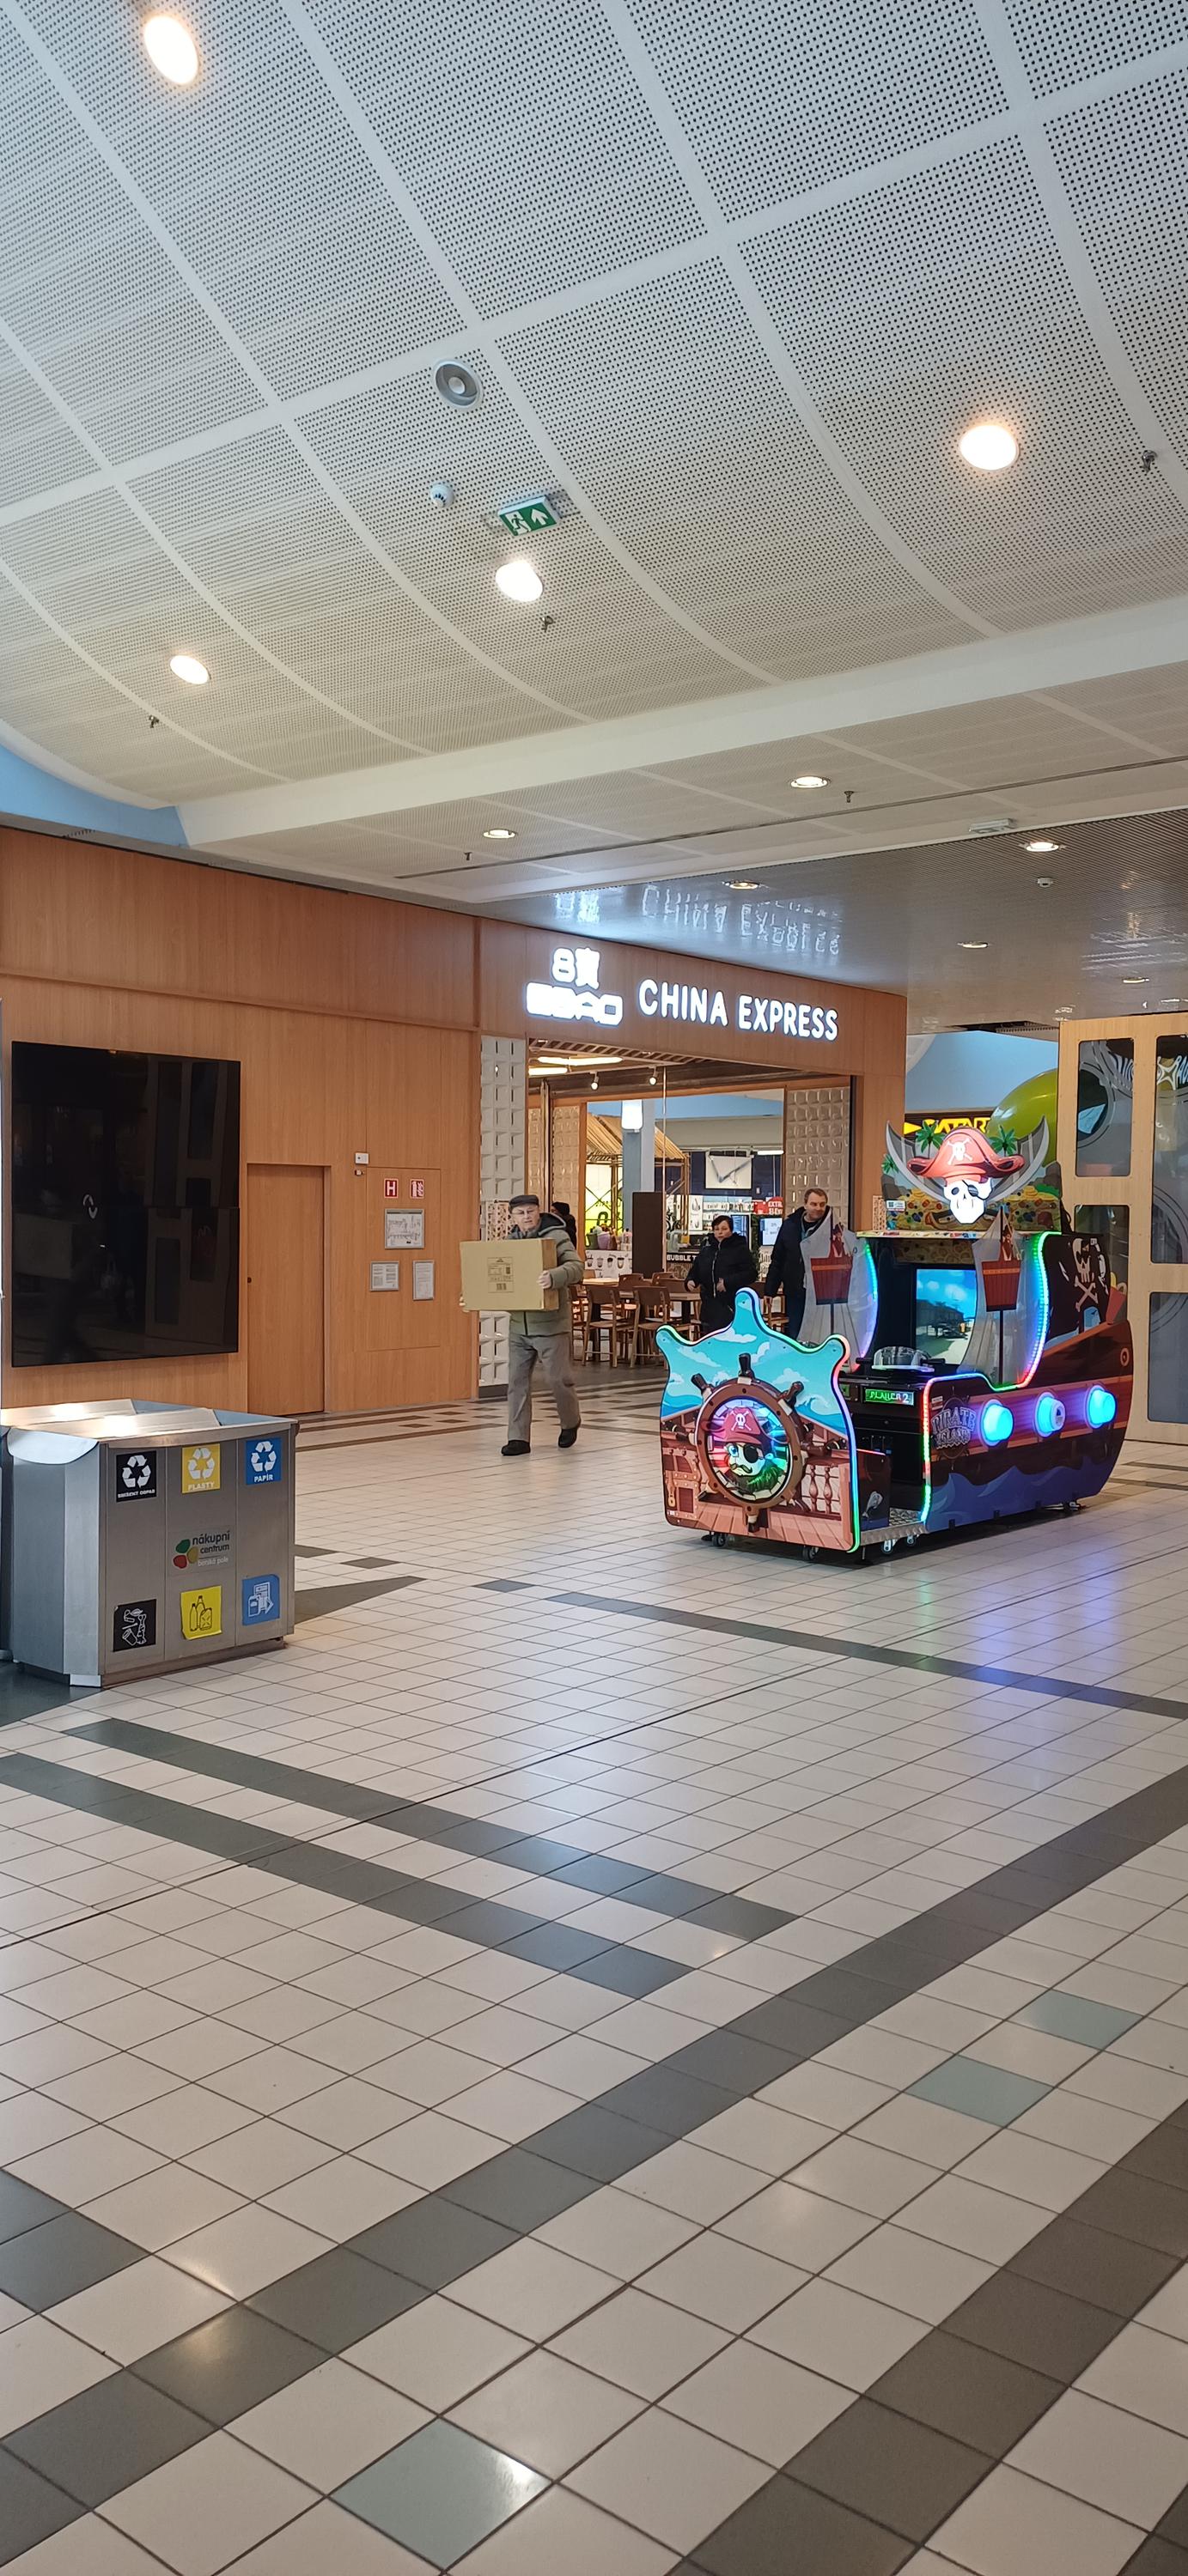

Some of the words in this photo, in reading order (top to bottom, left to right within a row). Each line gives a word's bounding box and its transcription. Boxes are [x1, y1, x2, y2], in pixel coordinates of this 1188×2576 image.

[638, 979, 728, 1027] CHINA
[738, 994, 838, 1041] EXPRESS
[902, 1393, 910, 1403] 2
[930, 1406, 977, 1435] PIRATE
[253, 1473, 273, 1483] PAPÍR
[187, 1481, 215, 1492] PLASTY
[192, 1530, 230, 1545] nákupní
[200, 1544, 230, 1554] centrum
